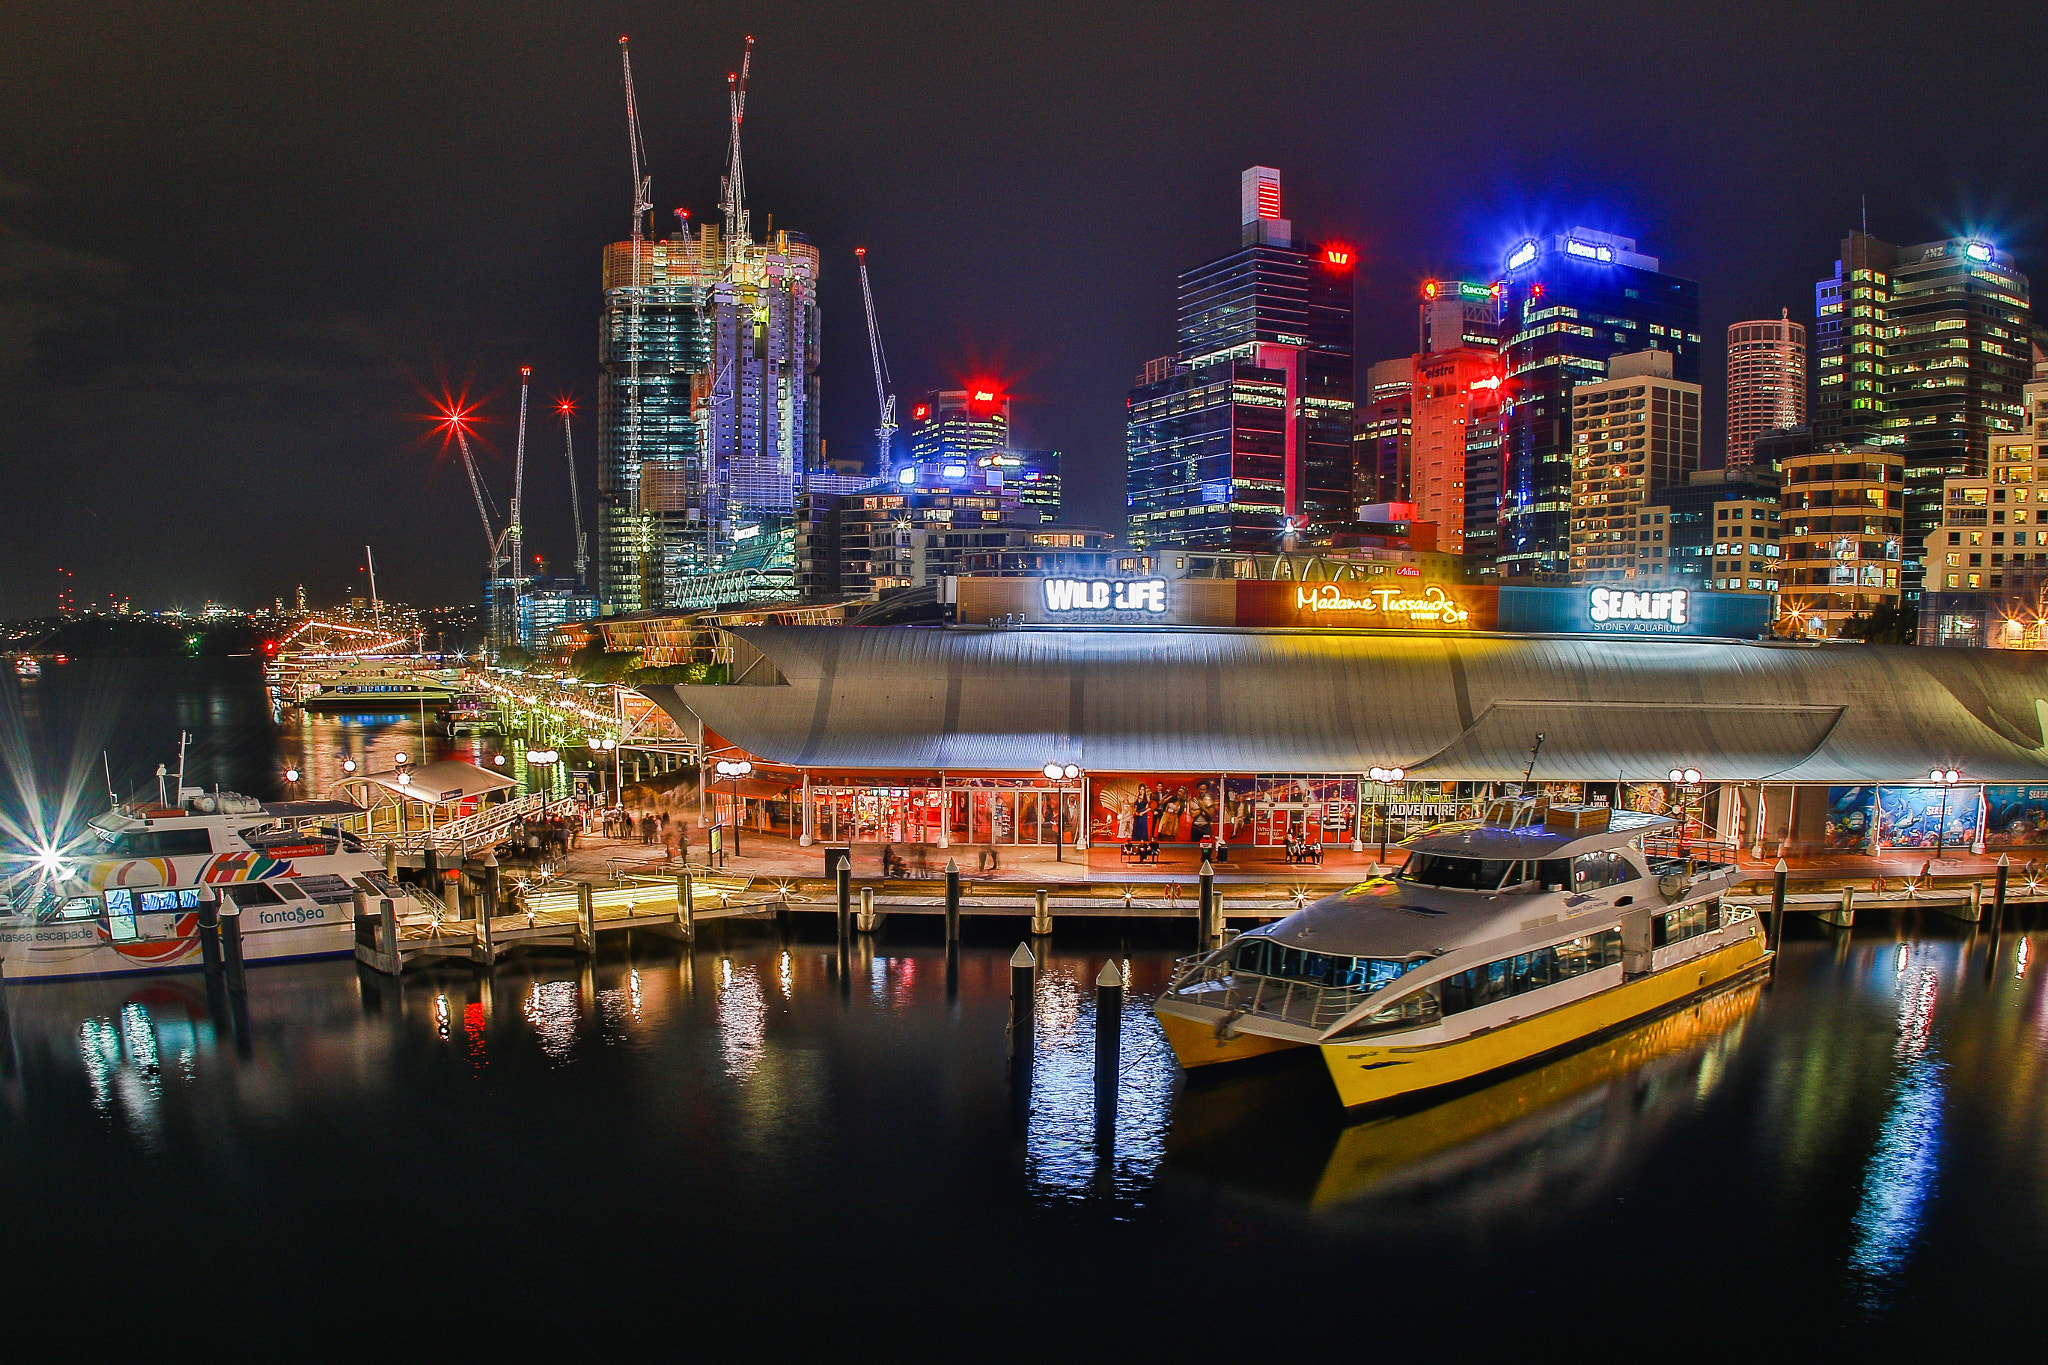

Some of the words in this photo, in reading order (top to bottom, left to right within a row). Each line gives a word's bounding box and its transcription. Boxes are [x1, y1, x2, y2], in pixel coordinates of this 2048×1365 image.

[1923, 246, 1944, 258] ANZ
[1462, 285, 1492, 296] SUNCORP
[1421, 365, 1455, 381] Telstra
[1045, 579, 1110, 610] WILD
[1115, 580, 1165, 611] LIFE
[1297, 585, 1377, 612] Madame
[1371, 586, 1458, 623] Tussauds
[1594, 623, 1630, 631] SYDNEY
[1633, 624, 1680, 633] AQUARIUM
[588, 688, 595, 696] 6
[1392, 787, 1405, 795] THE
[1391, 804, 1455, 816] ADVENTURE
[35, 927, 93, 942] escapade
